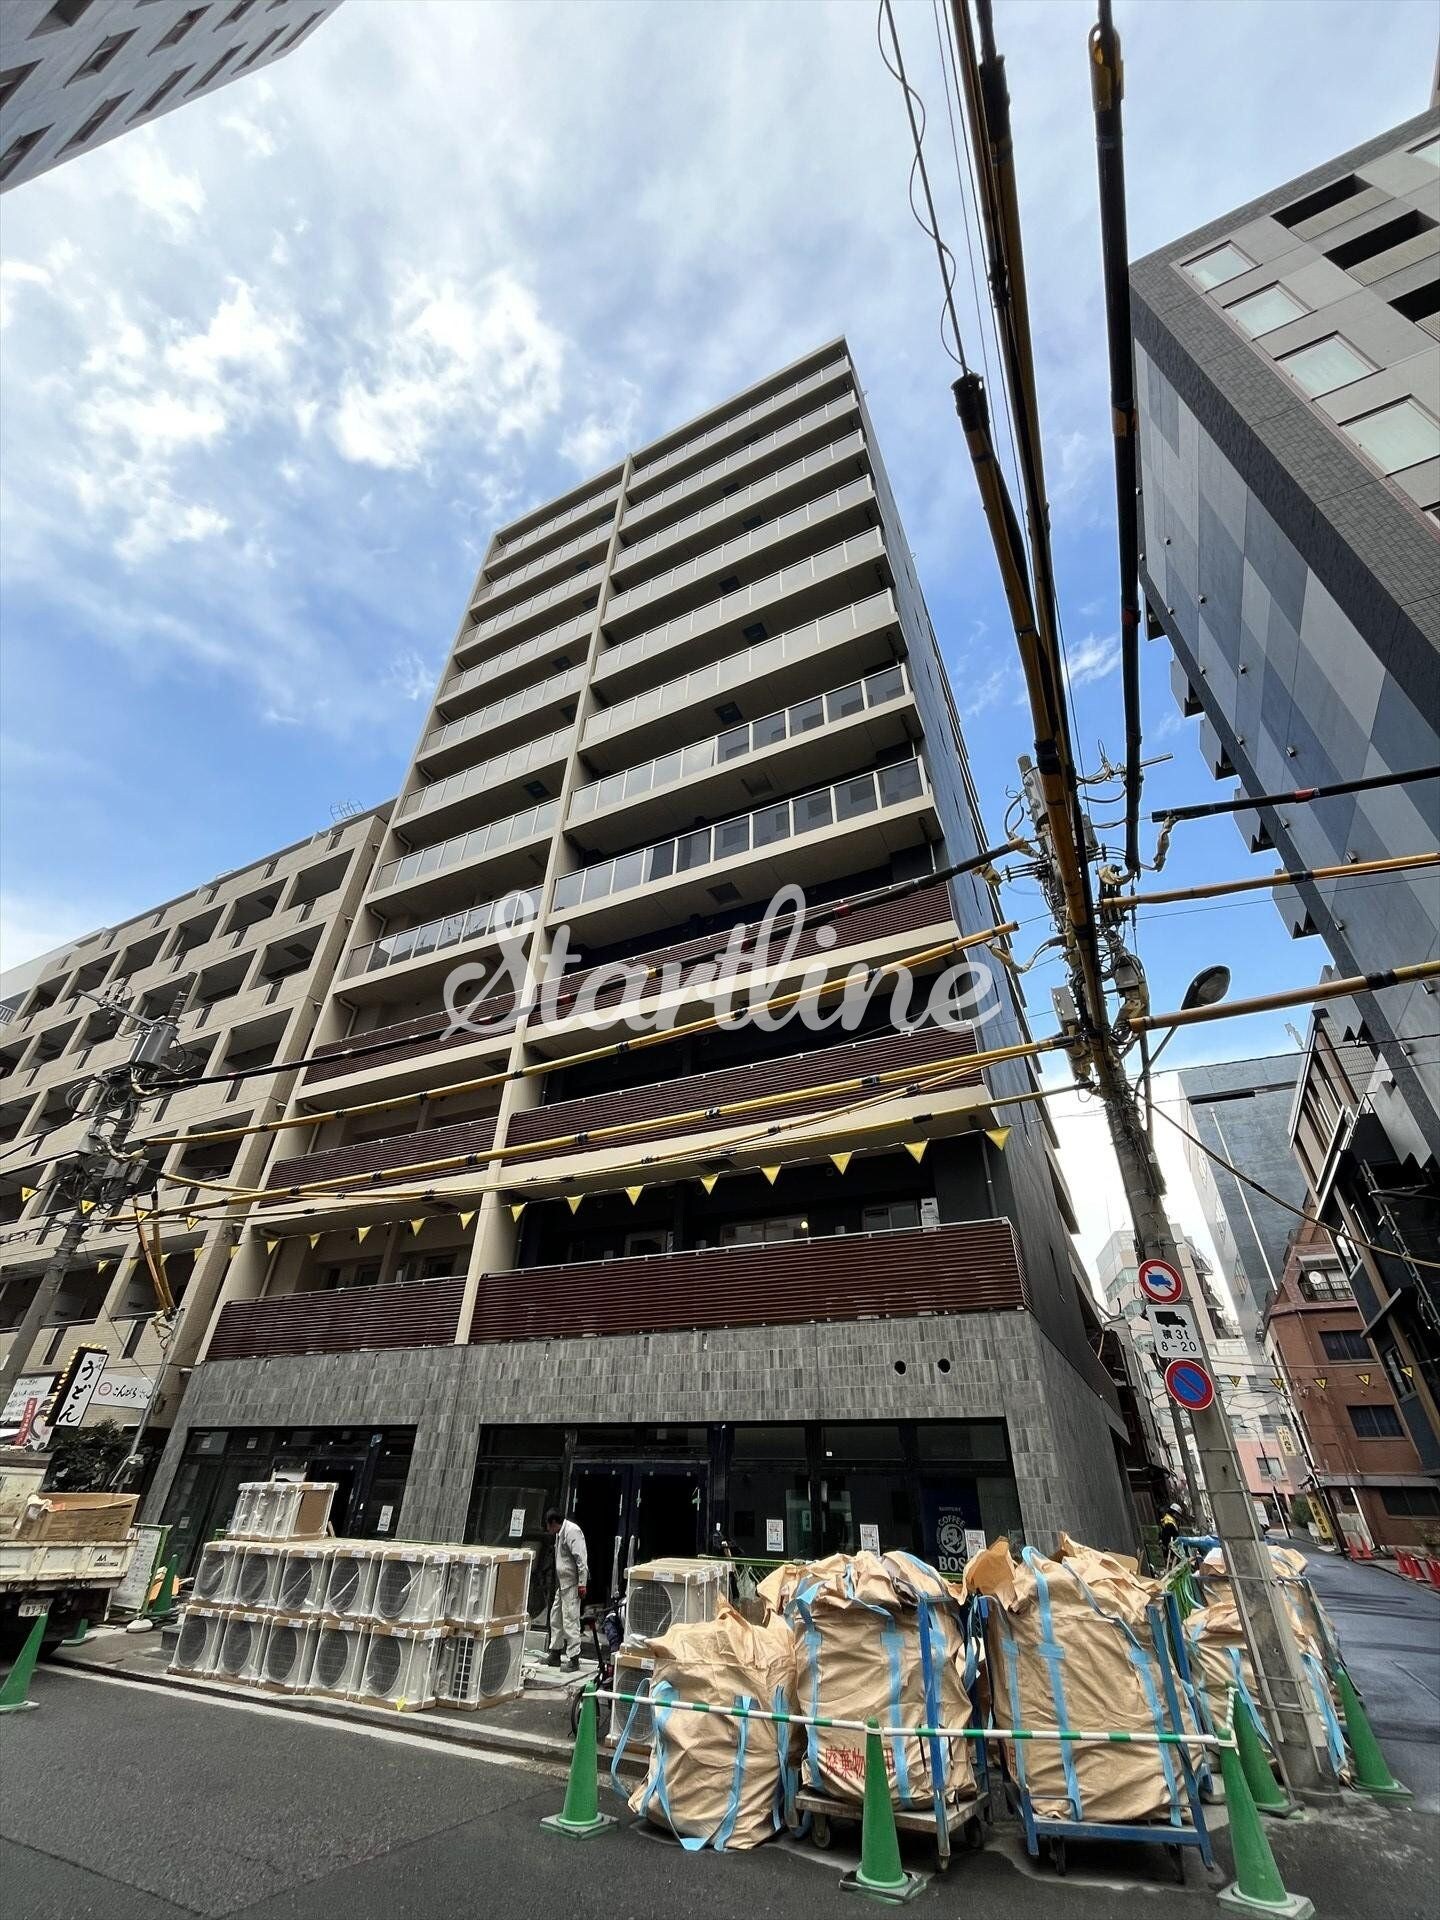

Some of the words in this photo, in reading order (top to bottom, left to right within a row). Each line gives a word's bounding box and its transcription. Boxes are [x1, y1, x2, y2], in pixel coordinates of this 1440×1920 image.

[1161, 1341, 1197, 1352] 8-20
[59, 1360, 95, 1423] うどん
[938, 1514, 966, 1529] COFFEE
[938, 1556, 966, 1572] BOS
